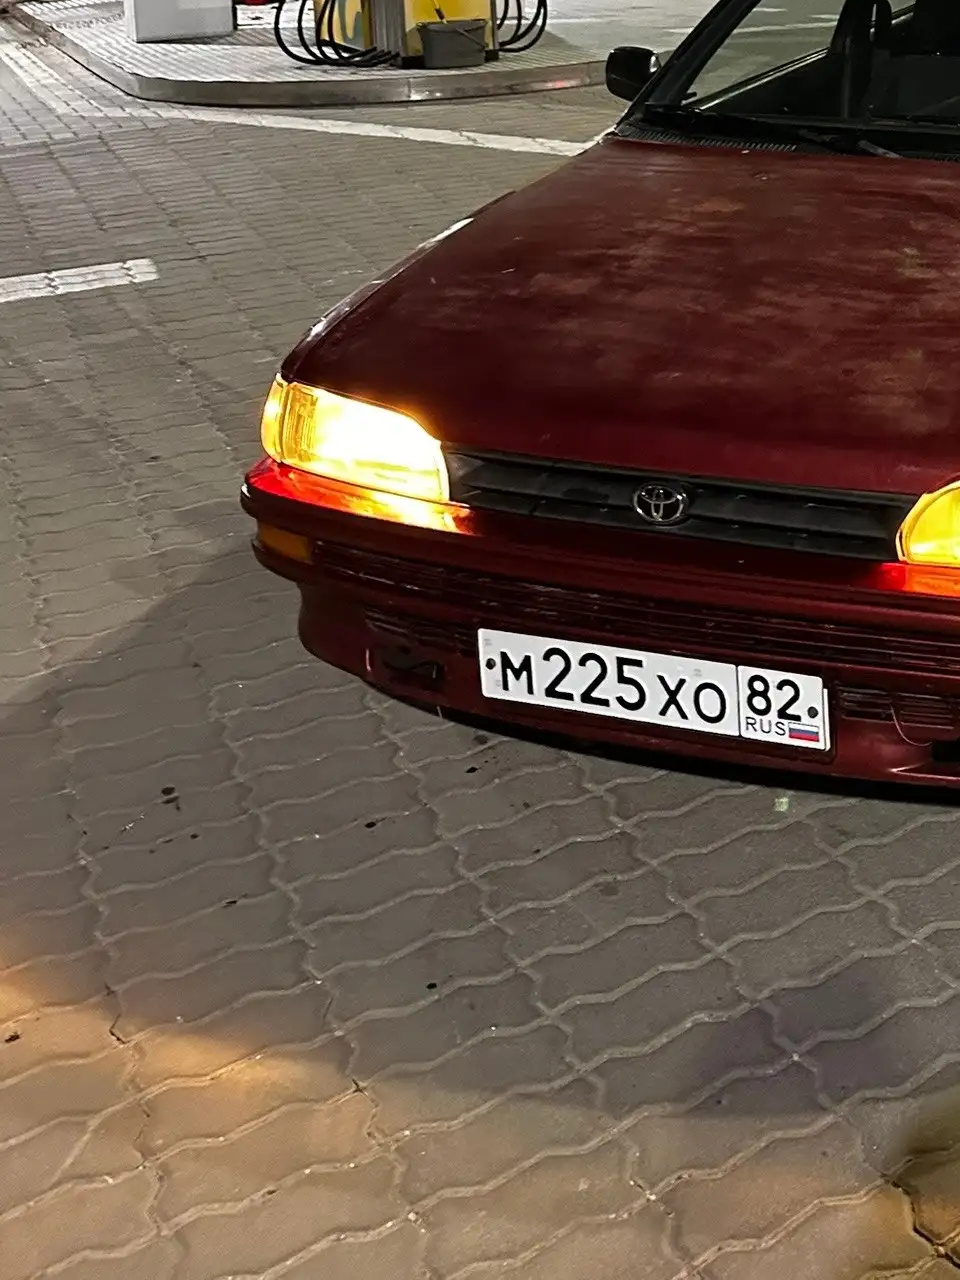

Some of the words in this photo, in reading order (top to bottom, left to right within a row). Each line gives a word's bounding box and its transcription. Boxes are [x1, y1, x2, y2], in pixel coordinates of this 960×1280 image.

[499, 647, 728, 724] М225ХО
[746, 674, 802, 722] 82
[744, 716, 786, 736] RUS
